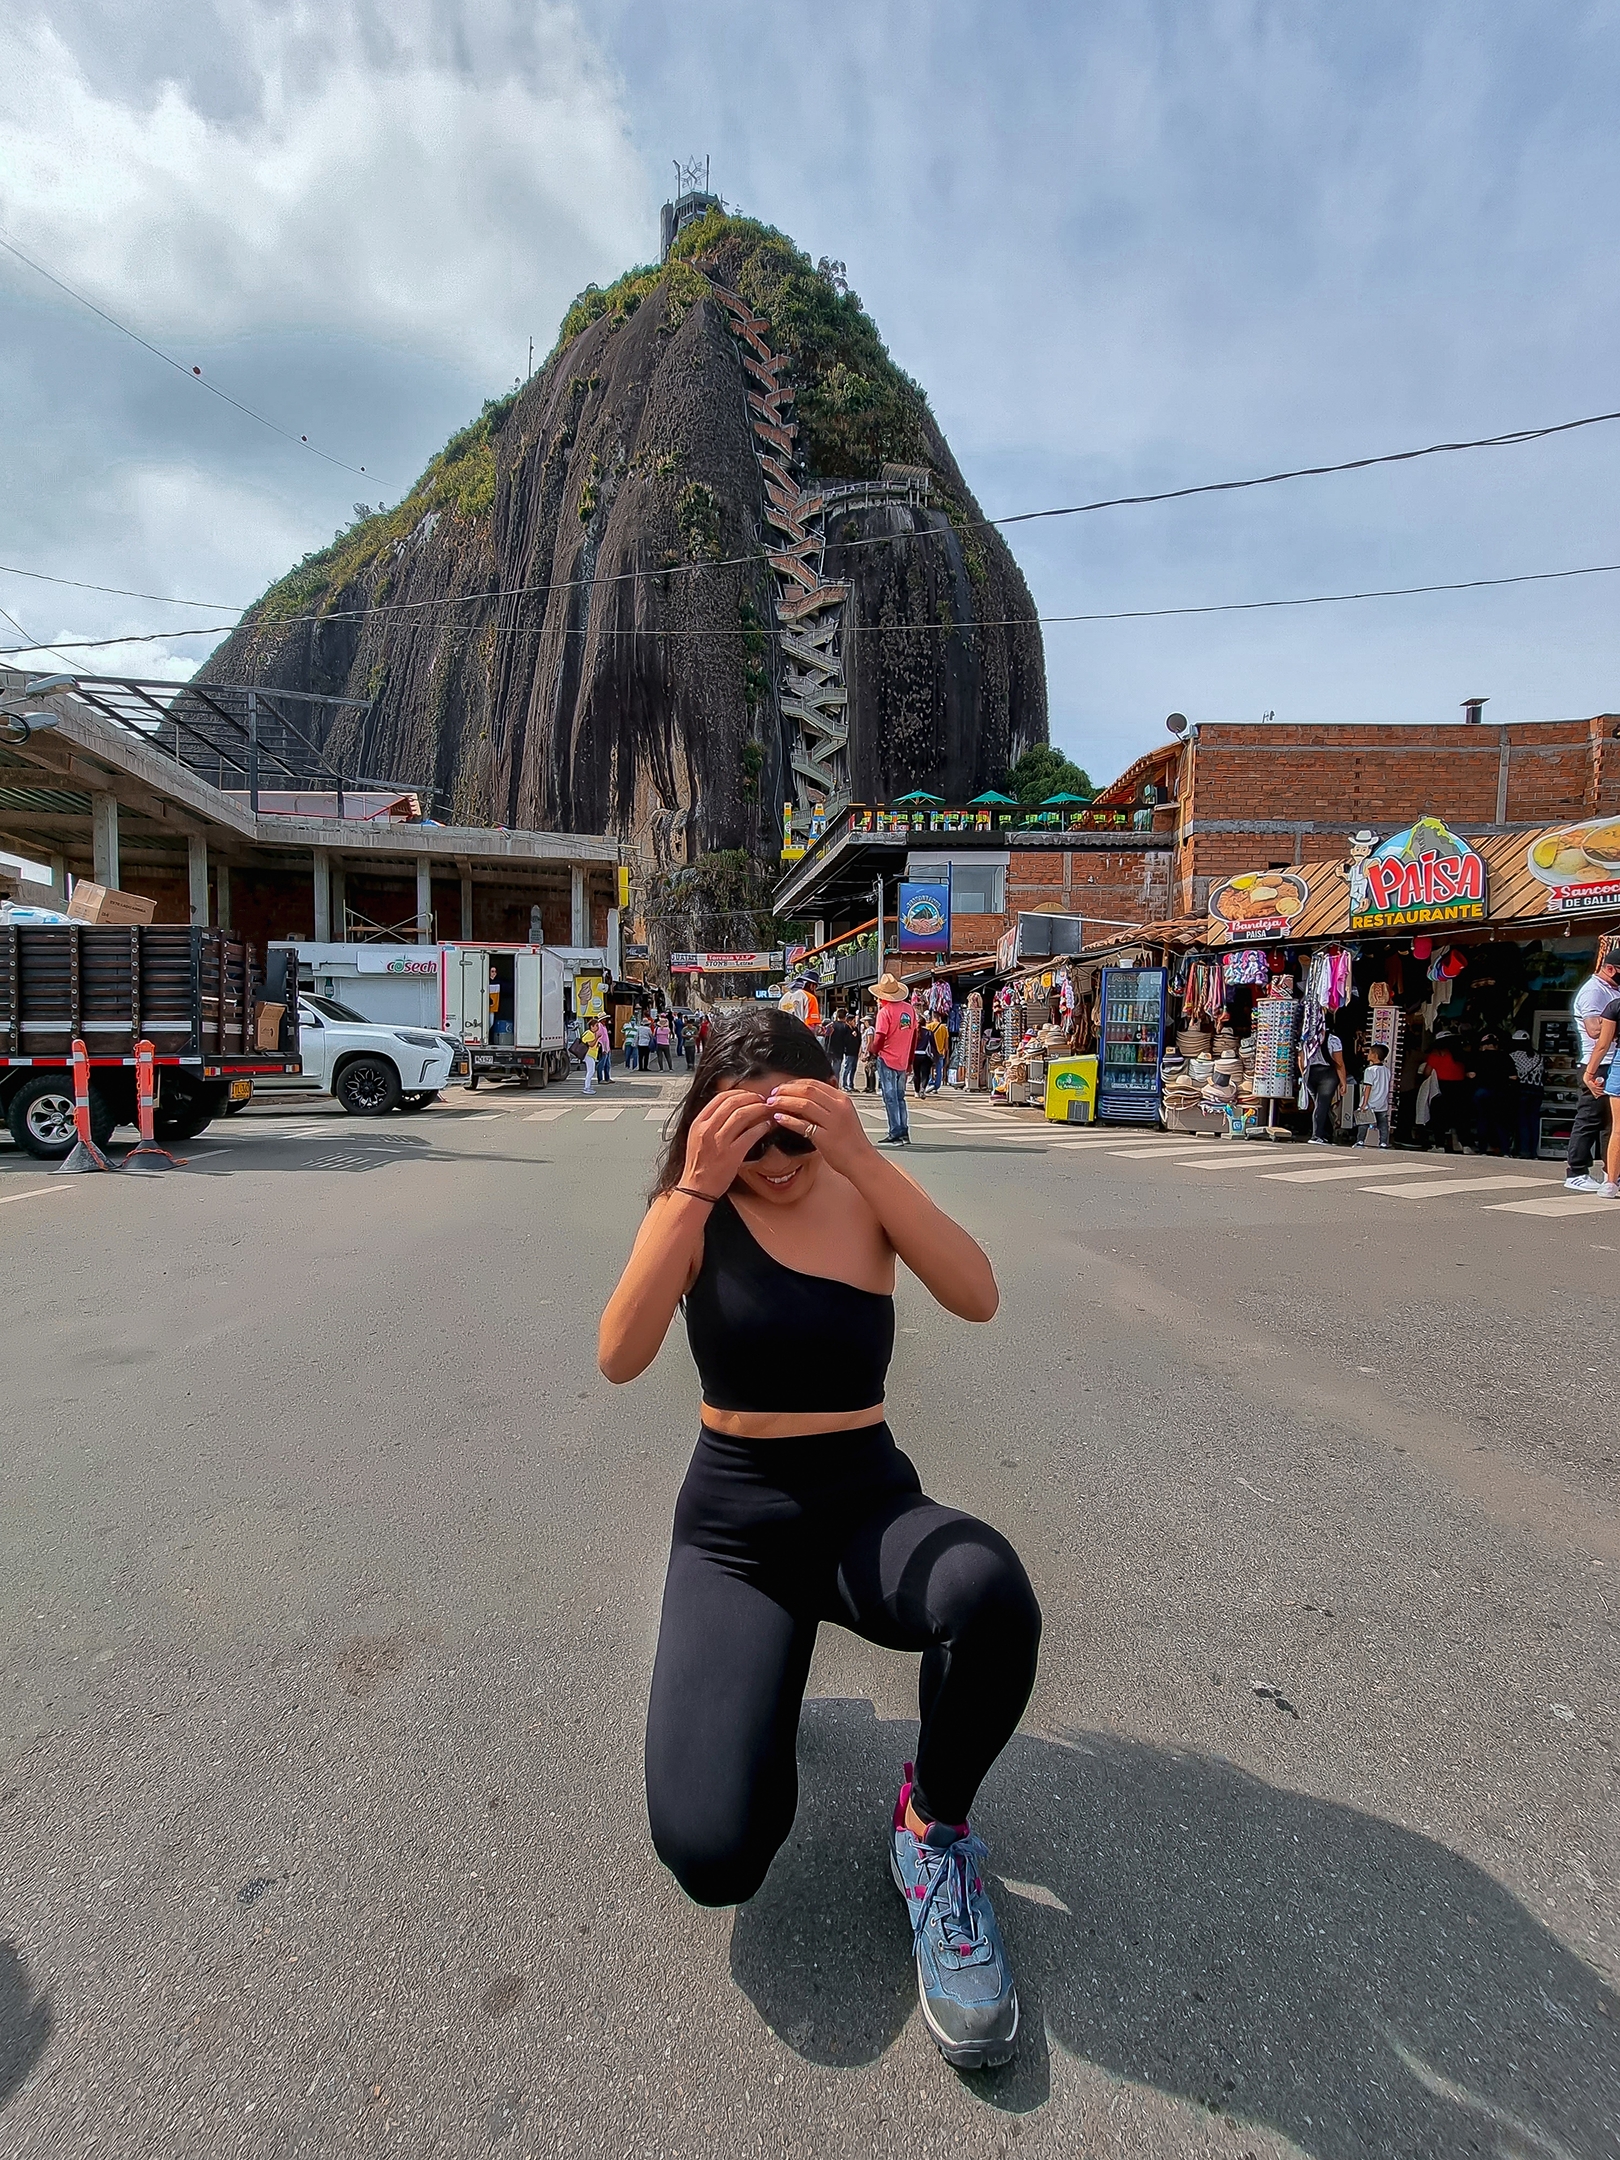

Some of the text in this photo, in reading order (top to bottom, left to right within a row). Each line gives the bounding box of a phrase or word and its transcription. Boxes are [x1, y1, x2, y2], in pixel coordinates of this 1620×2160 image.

[1561, 883, 1620, 898] Sancoc
[1565, 898, 1581, 908] DE
[1352, 903, 1483, 929] RESTAURANTE
[1232, 919, 1282, 931] Bandeja
